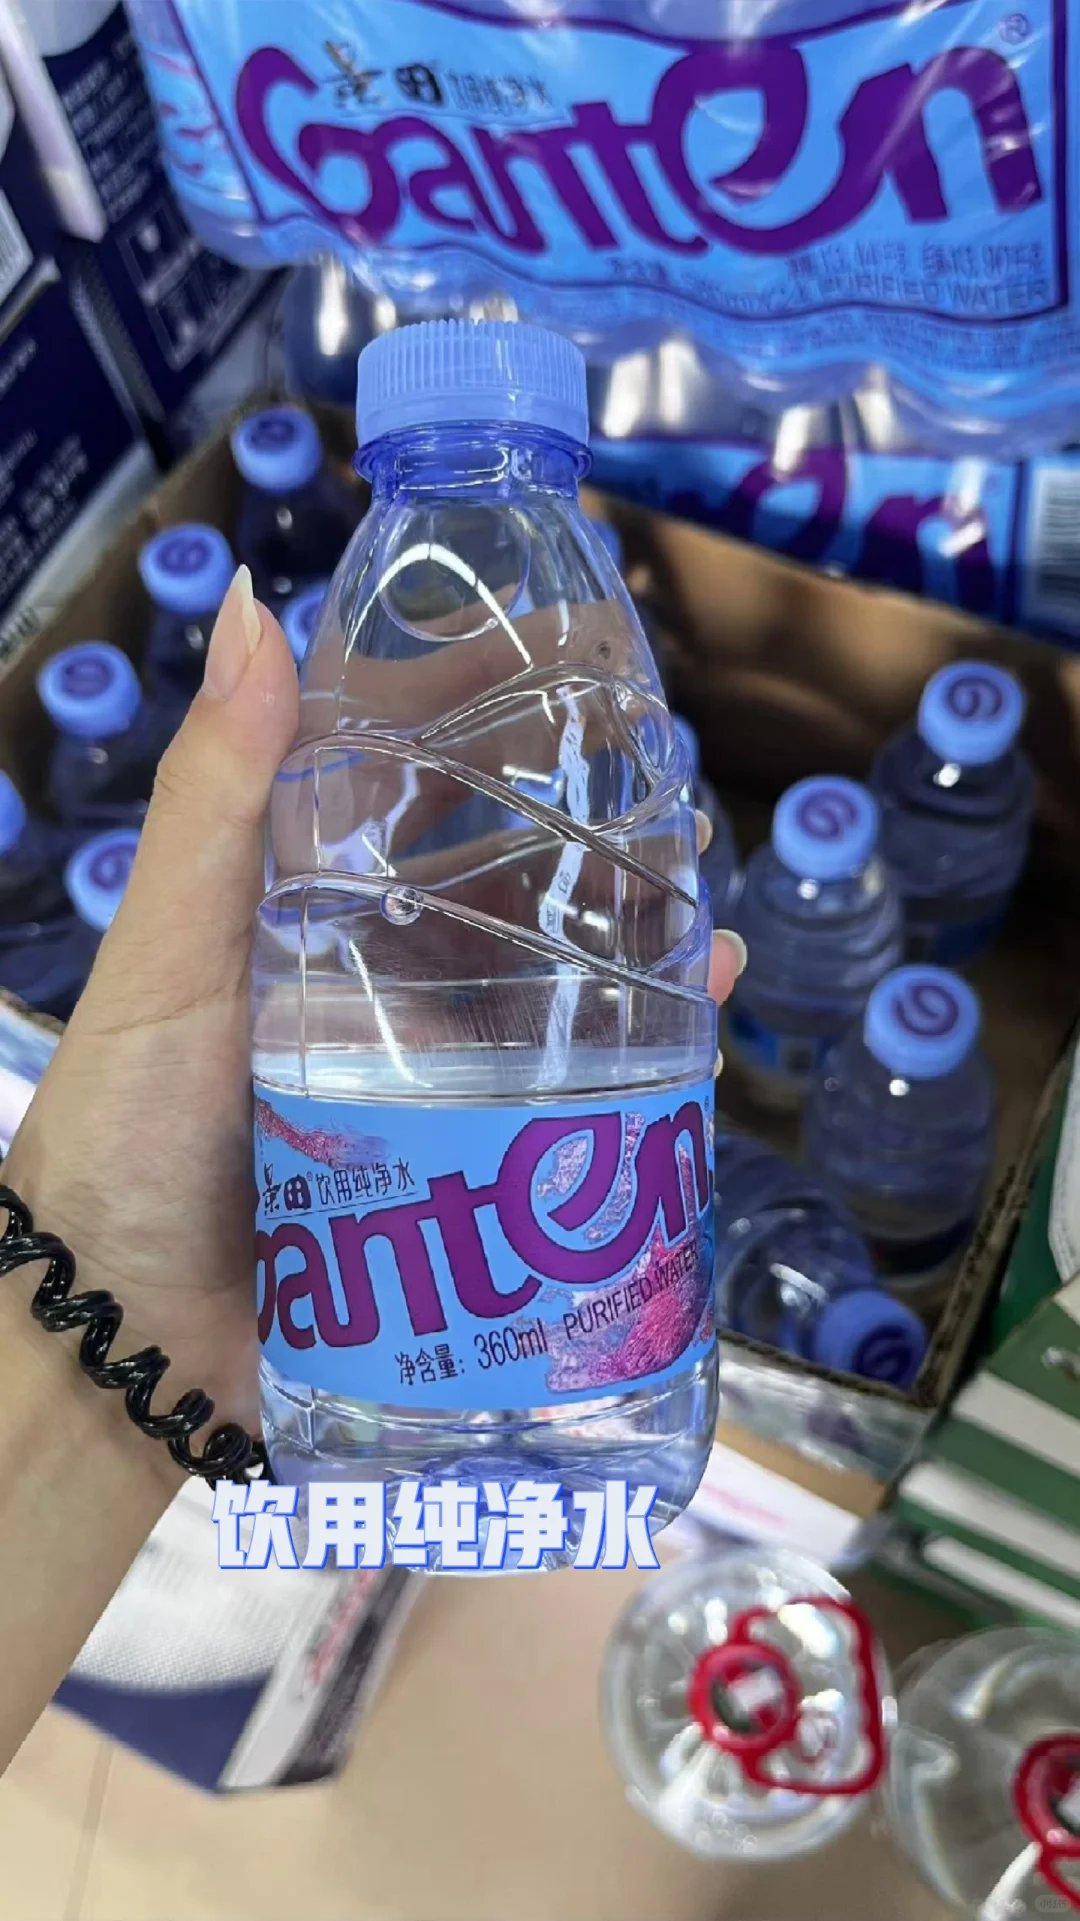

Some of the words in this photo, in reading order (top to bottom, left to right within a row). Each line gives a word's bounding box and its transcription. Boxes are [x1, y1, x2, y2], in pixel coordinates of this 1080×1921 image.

[316, 1156, 416, 1206] 饮用纯净水
[254, 1101, 708, 1351] anten
[563, 1275, 654, 1340] PURIFIED
[654, 1239, 700, 1289] WATER
[473, 1316, 549, 1371] 360ml
